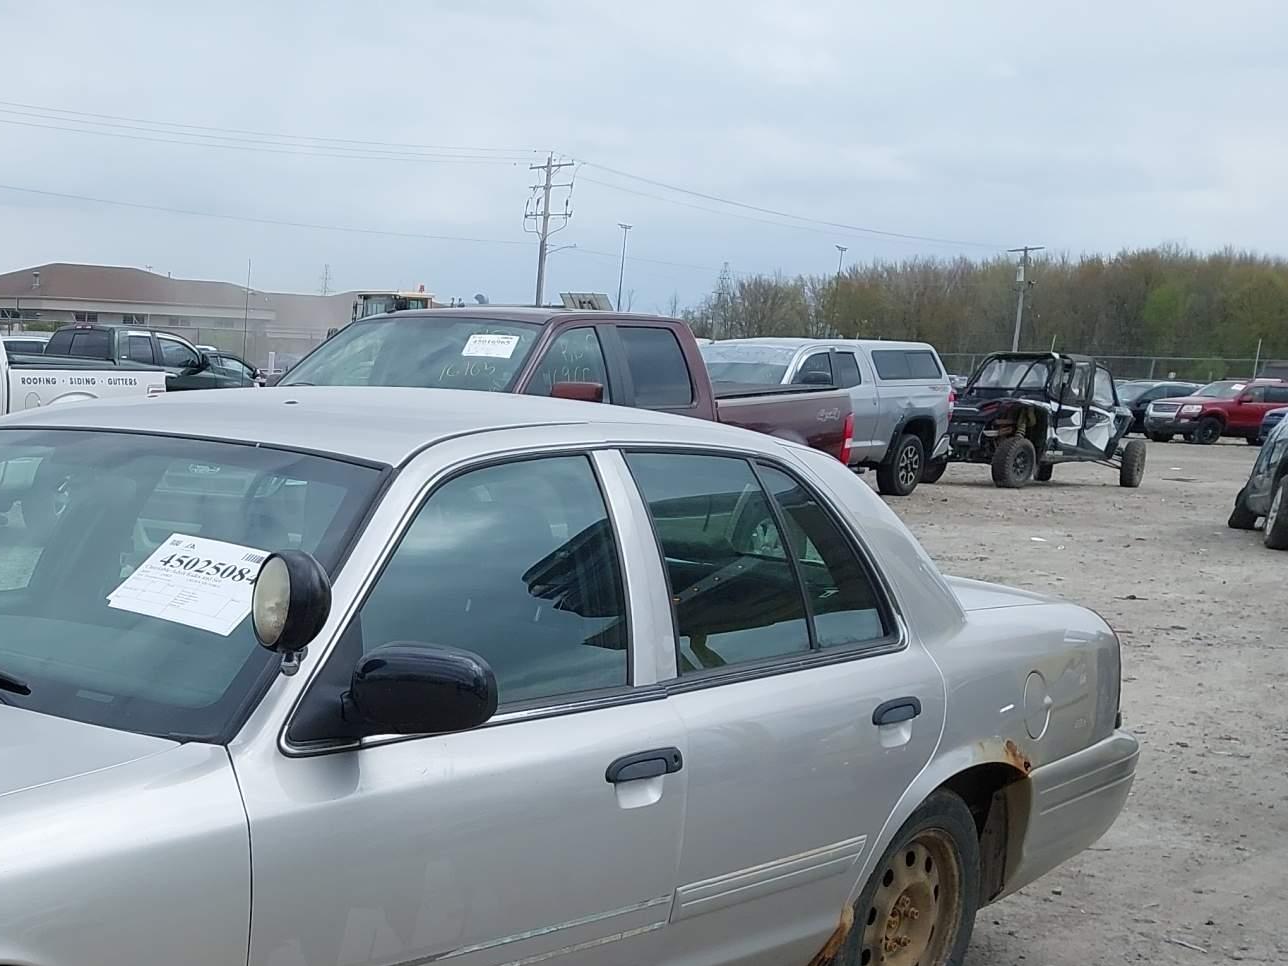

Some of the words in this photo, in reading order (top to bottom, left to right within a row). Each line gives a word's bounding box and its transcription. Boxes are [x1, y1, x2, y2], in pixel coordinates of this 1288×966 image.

[21, 377, 57, 385] ROOFING
[69, 377, 96, 385] SIDING
[107, 377, 138, 386] GUTTERS
[160, 553, 257, 585] 45025084
